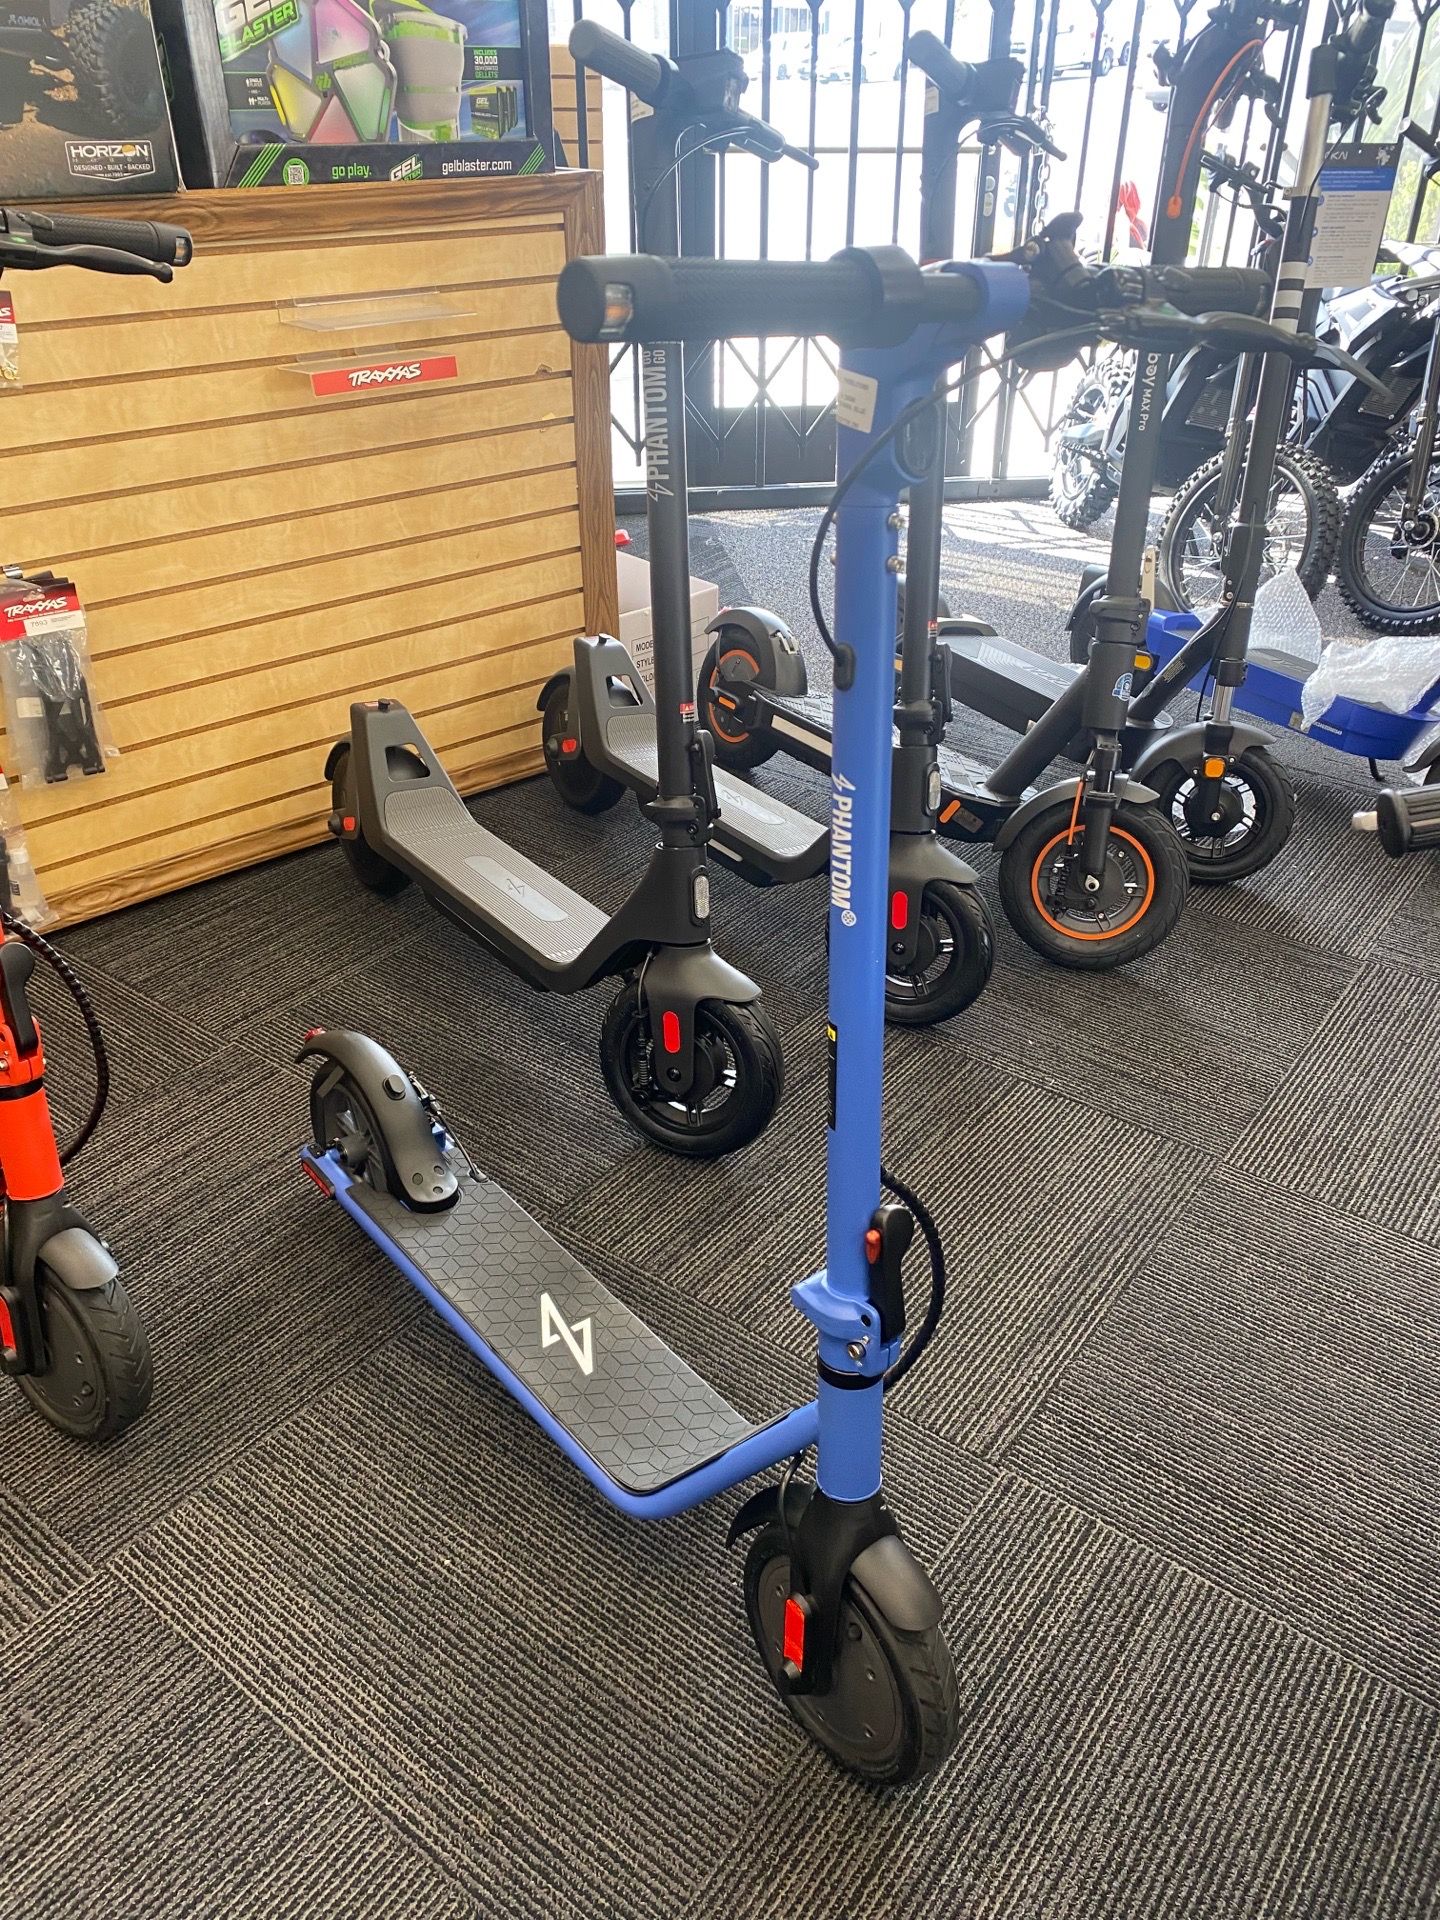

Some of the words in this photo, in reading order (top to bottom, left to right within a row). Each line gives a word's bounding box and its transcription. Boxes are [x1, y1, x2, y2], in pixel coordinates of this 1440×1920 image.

[220, 1, 295, 56] BLASTER
[474, 56, 498, 65] 30,000
[70, 144, 149, 157] HORIZON
[331, 166, 345, 179] go
[347, 162, 372, 178] play.
[390, 156, 421, 181] GEL
[442, 159, 512, 175] gelblaster.com
[652, 349, 666, 364] GO
[349, 363, 422, 387] TRAXXAS
[1142, 353, 1161, 386] boy
[1141, 388, 1153, 411] MAX
[643, 366, 669, 480] PHANTOM
[1138, 413, 1149, 431] Pro
[3, 596, 68, 617] TRAXXAS
[635, 640, 654, 652] MODE
[831, 794, 853, 909] PHANTOM
